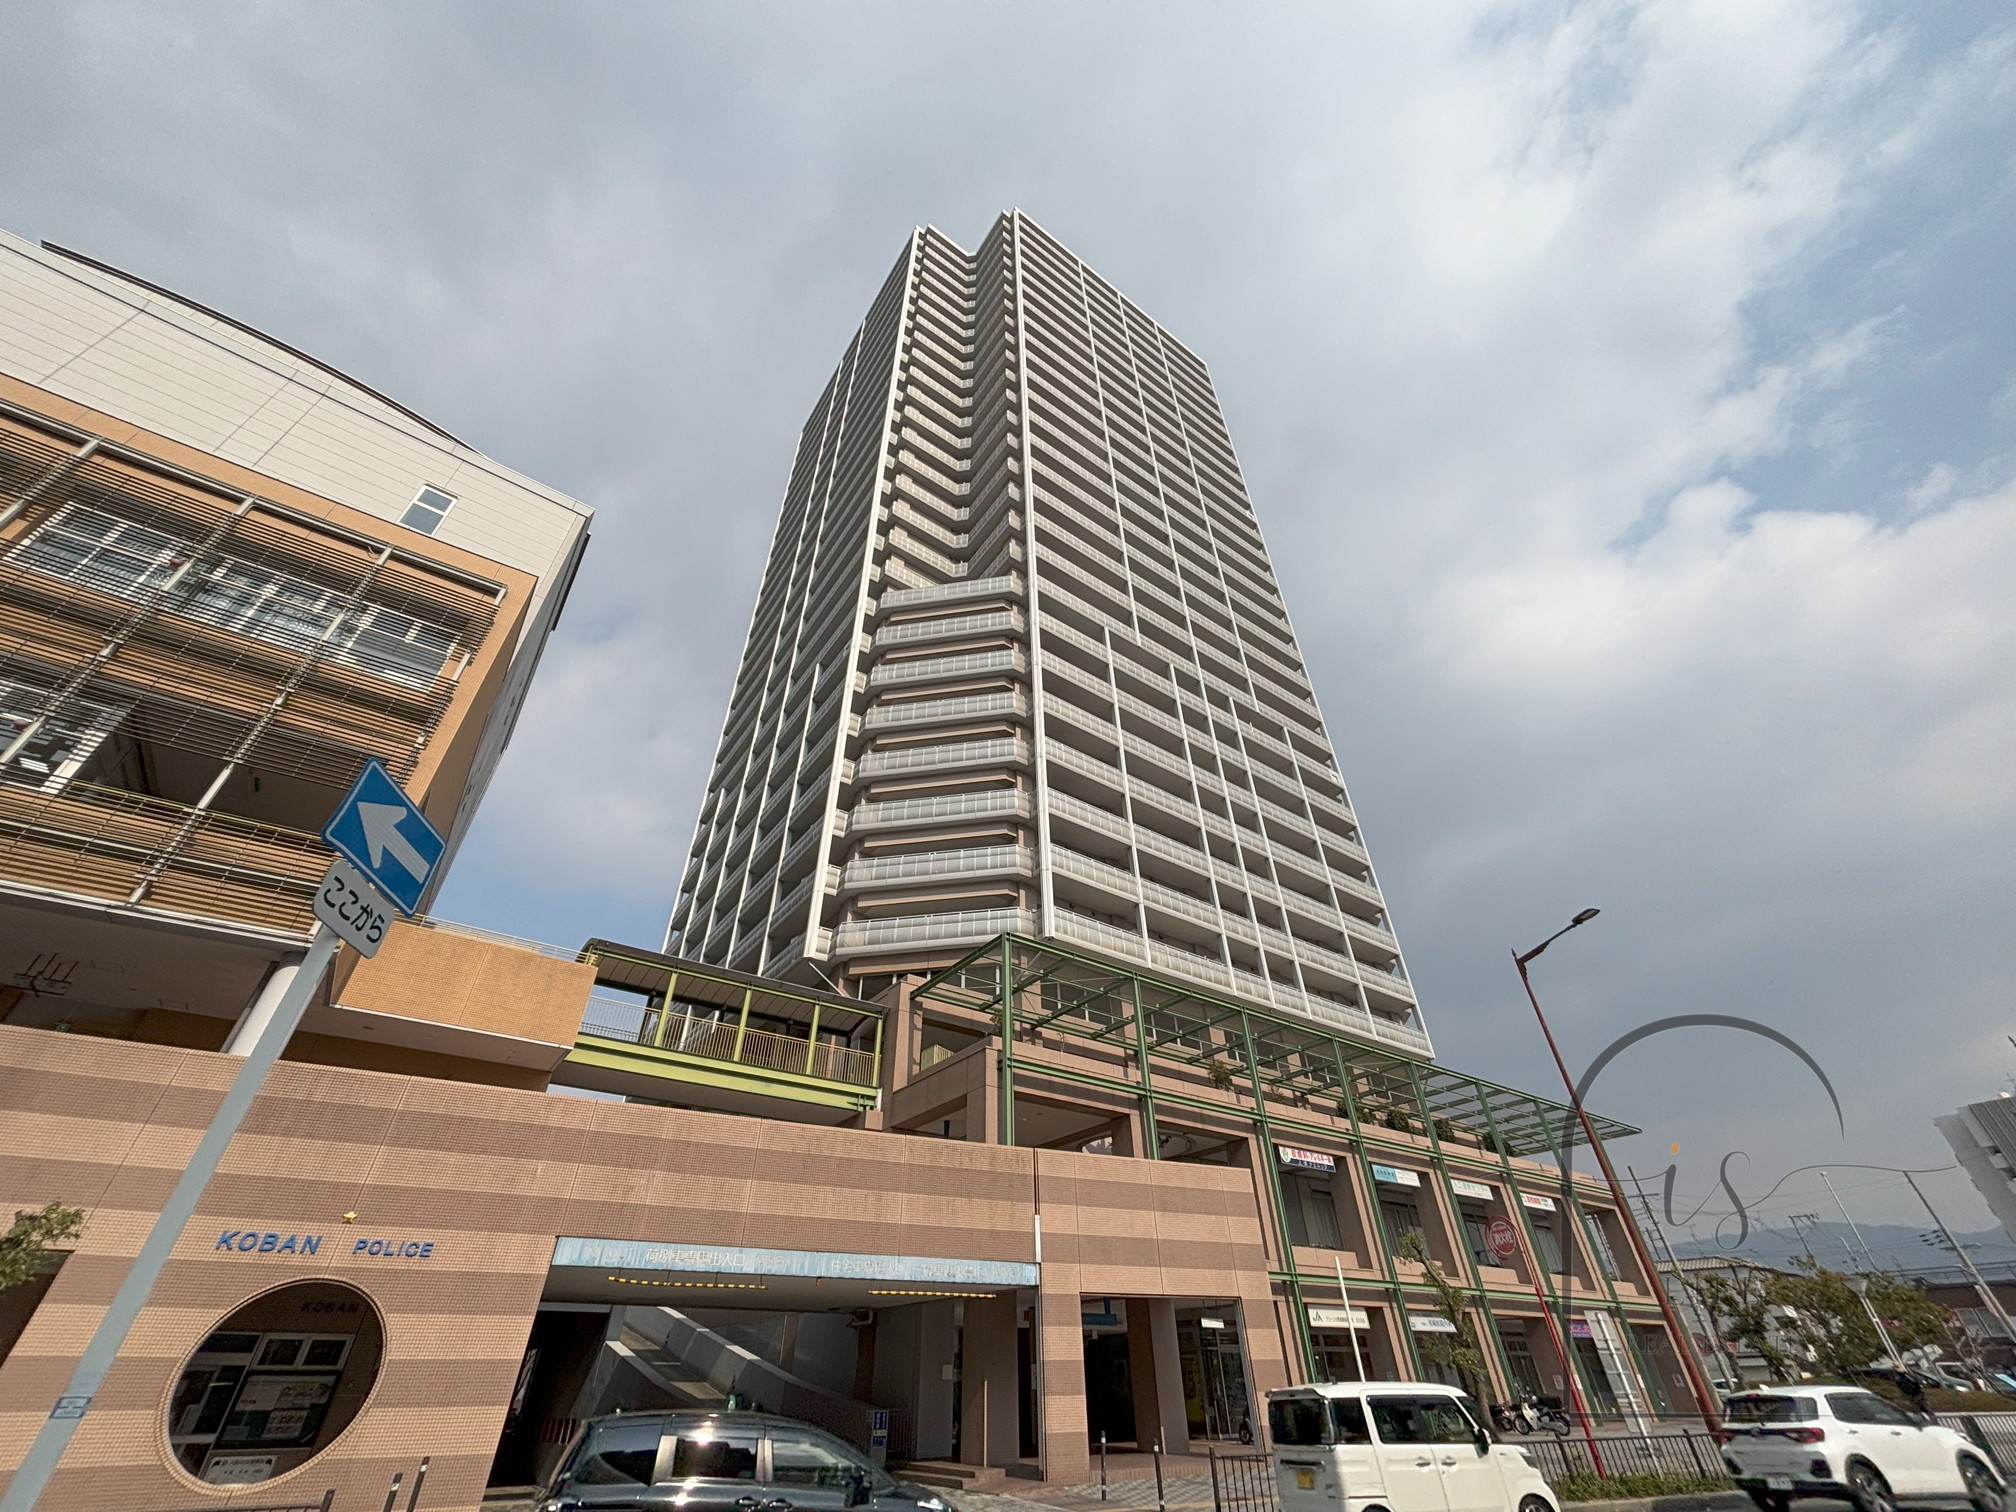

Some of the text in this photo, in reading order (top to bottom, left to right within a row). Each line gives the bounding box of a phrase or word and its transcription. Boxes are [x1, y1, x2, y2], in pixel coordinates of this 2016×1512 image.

[323, 875, 385, 943] ここから
[216, 1230, 435, 1258] KOBAN POLICE
[1492, 1230, 1514, 1246] 消火栓
[301, 1301, 360, 1314] KOBAN
[1312, 1311, 1323, 1322] JA
